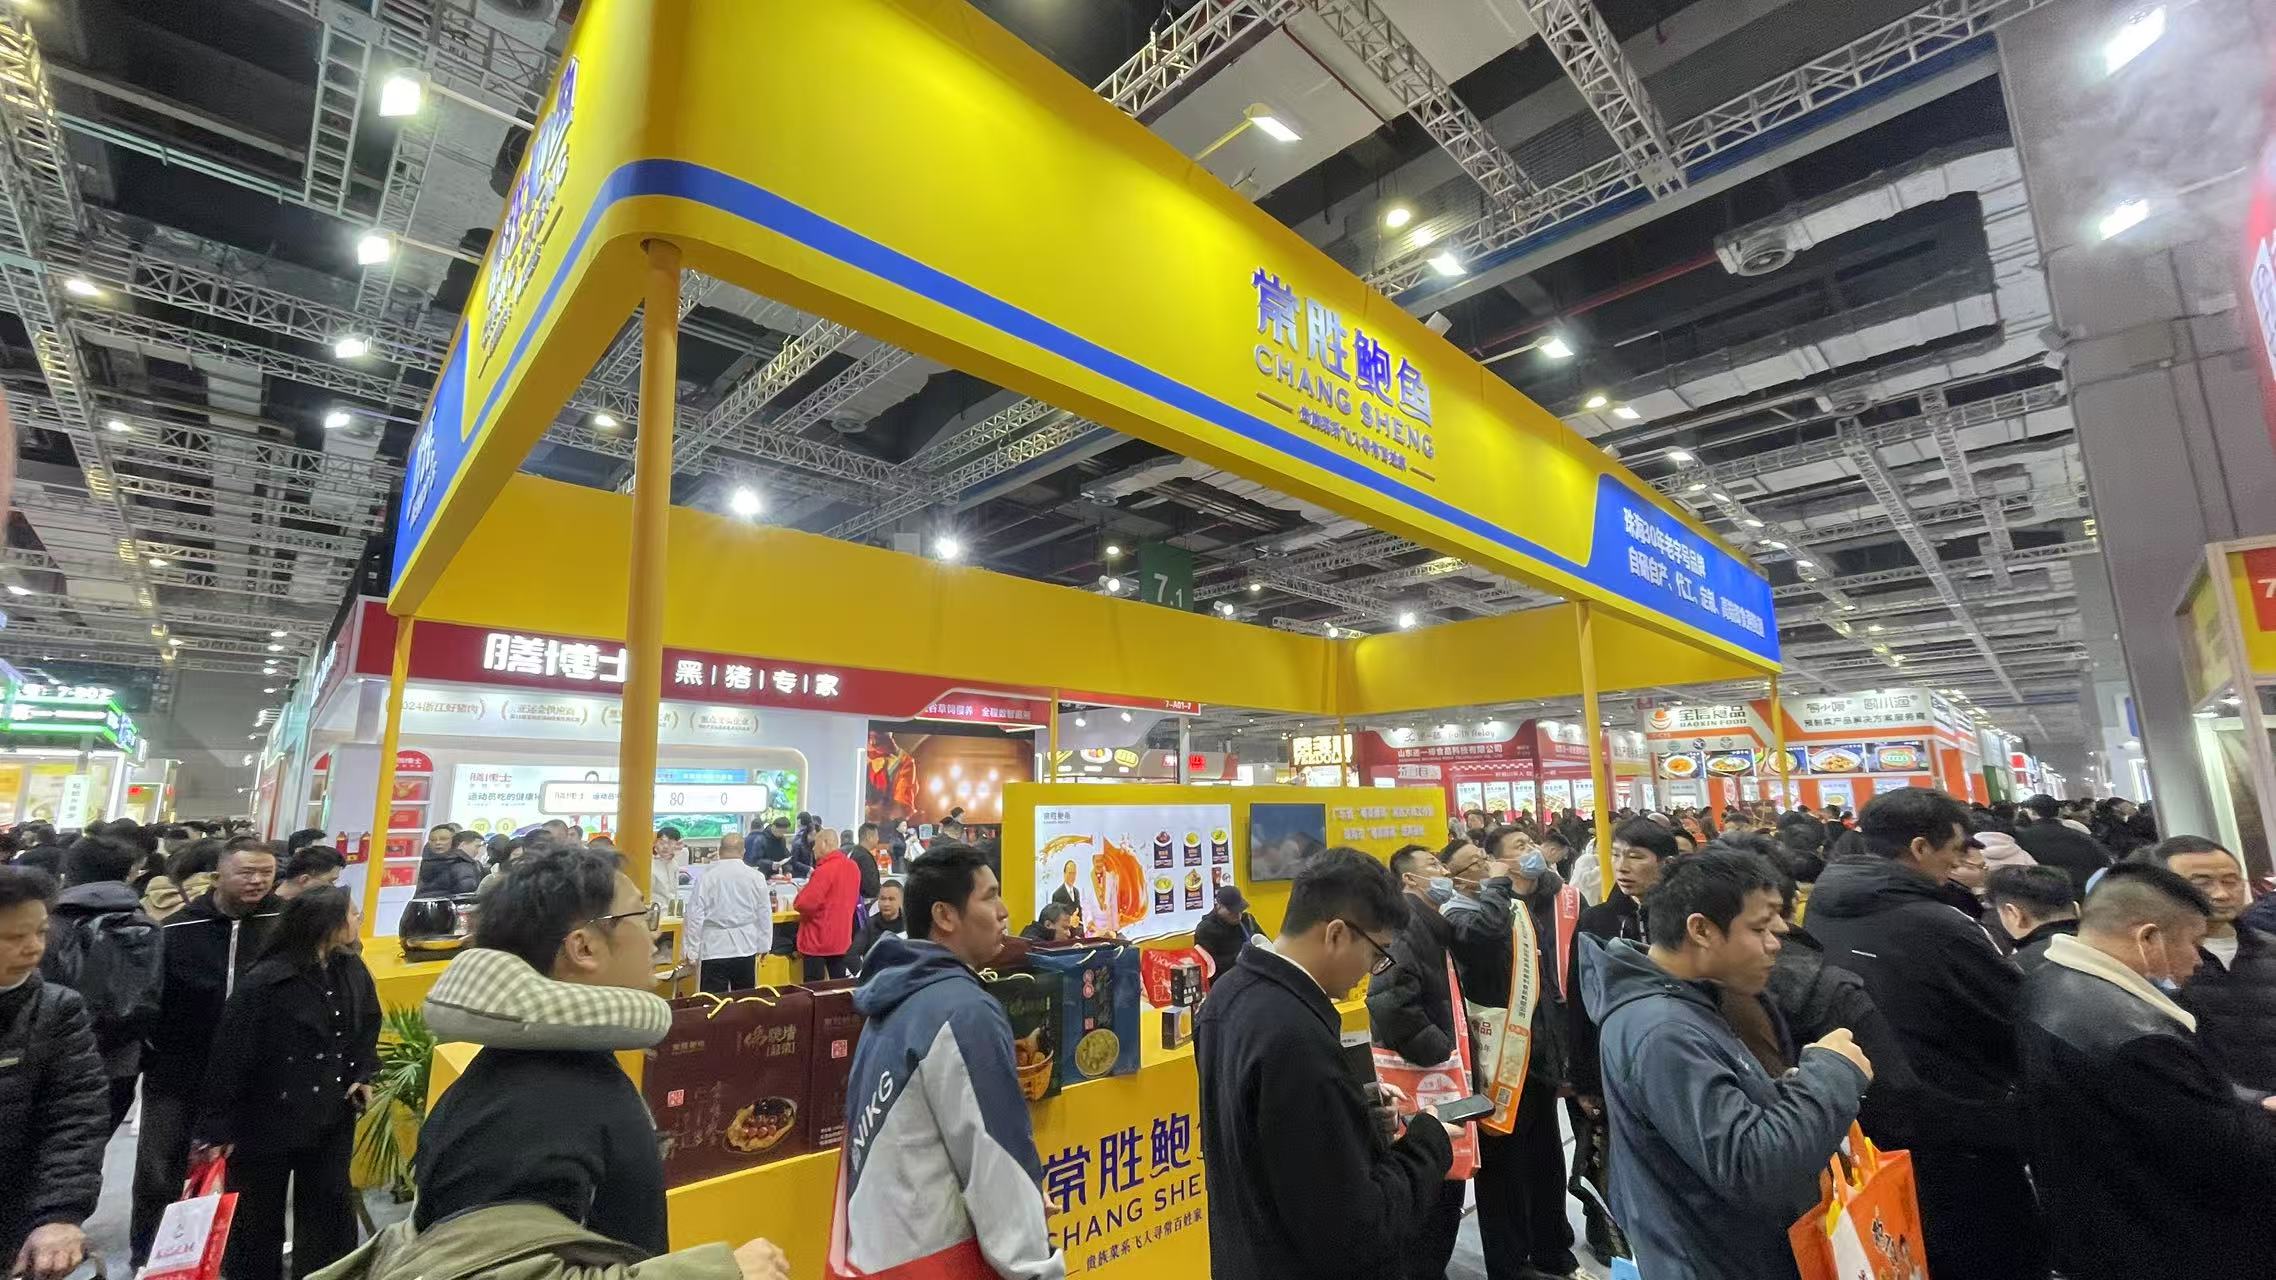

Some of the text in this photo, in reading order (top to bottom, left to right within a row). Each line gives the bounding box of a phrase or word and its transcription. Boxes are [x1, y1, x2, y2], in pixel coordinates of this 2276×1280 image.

[1252, 267, 1432, 428] 常胜鲍鱼
[1254, 344, 1435, 459] CHANG SHENG
[1042, 1112, 1205, 1214] 常胜鲍
